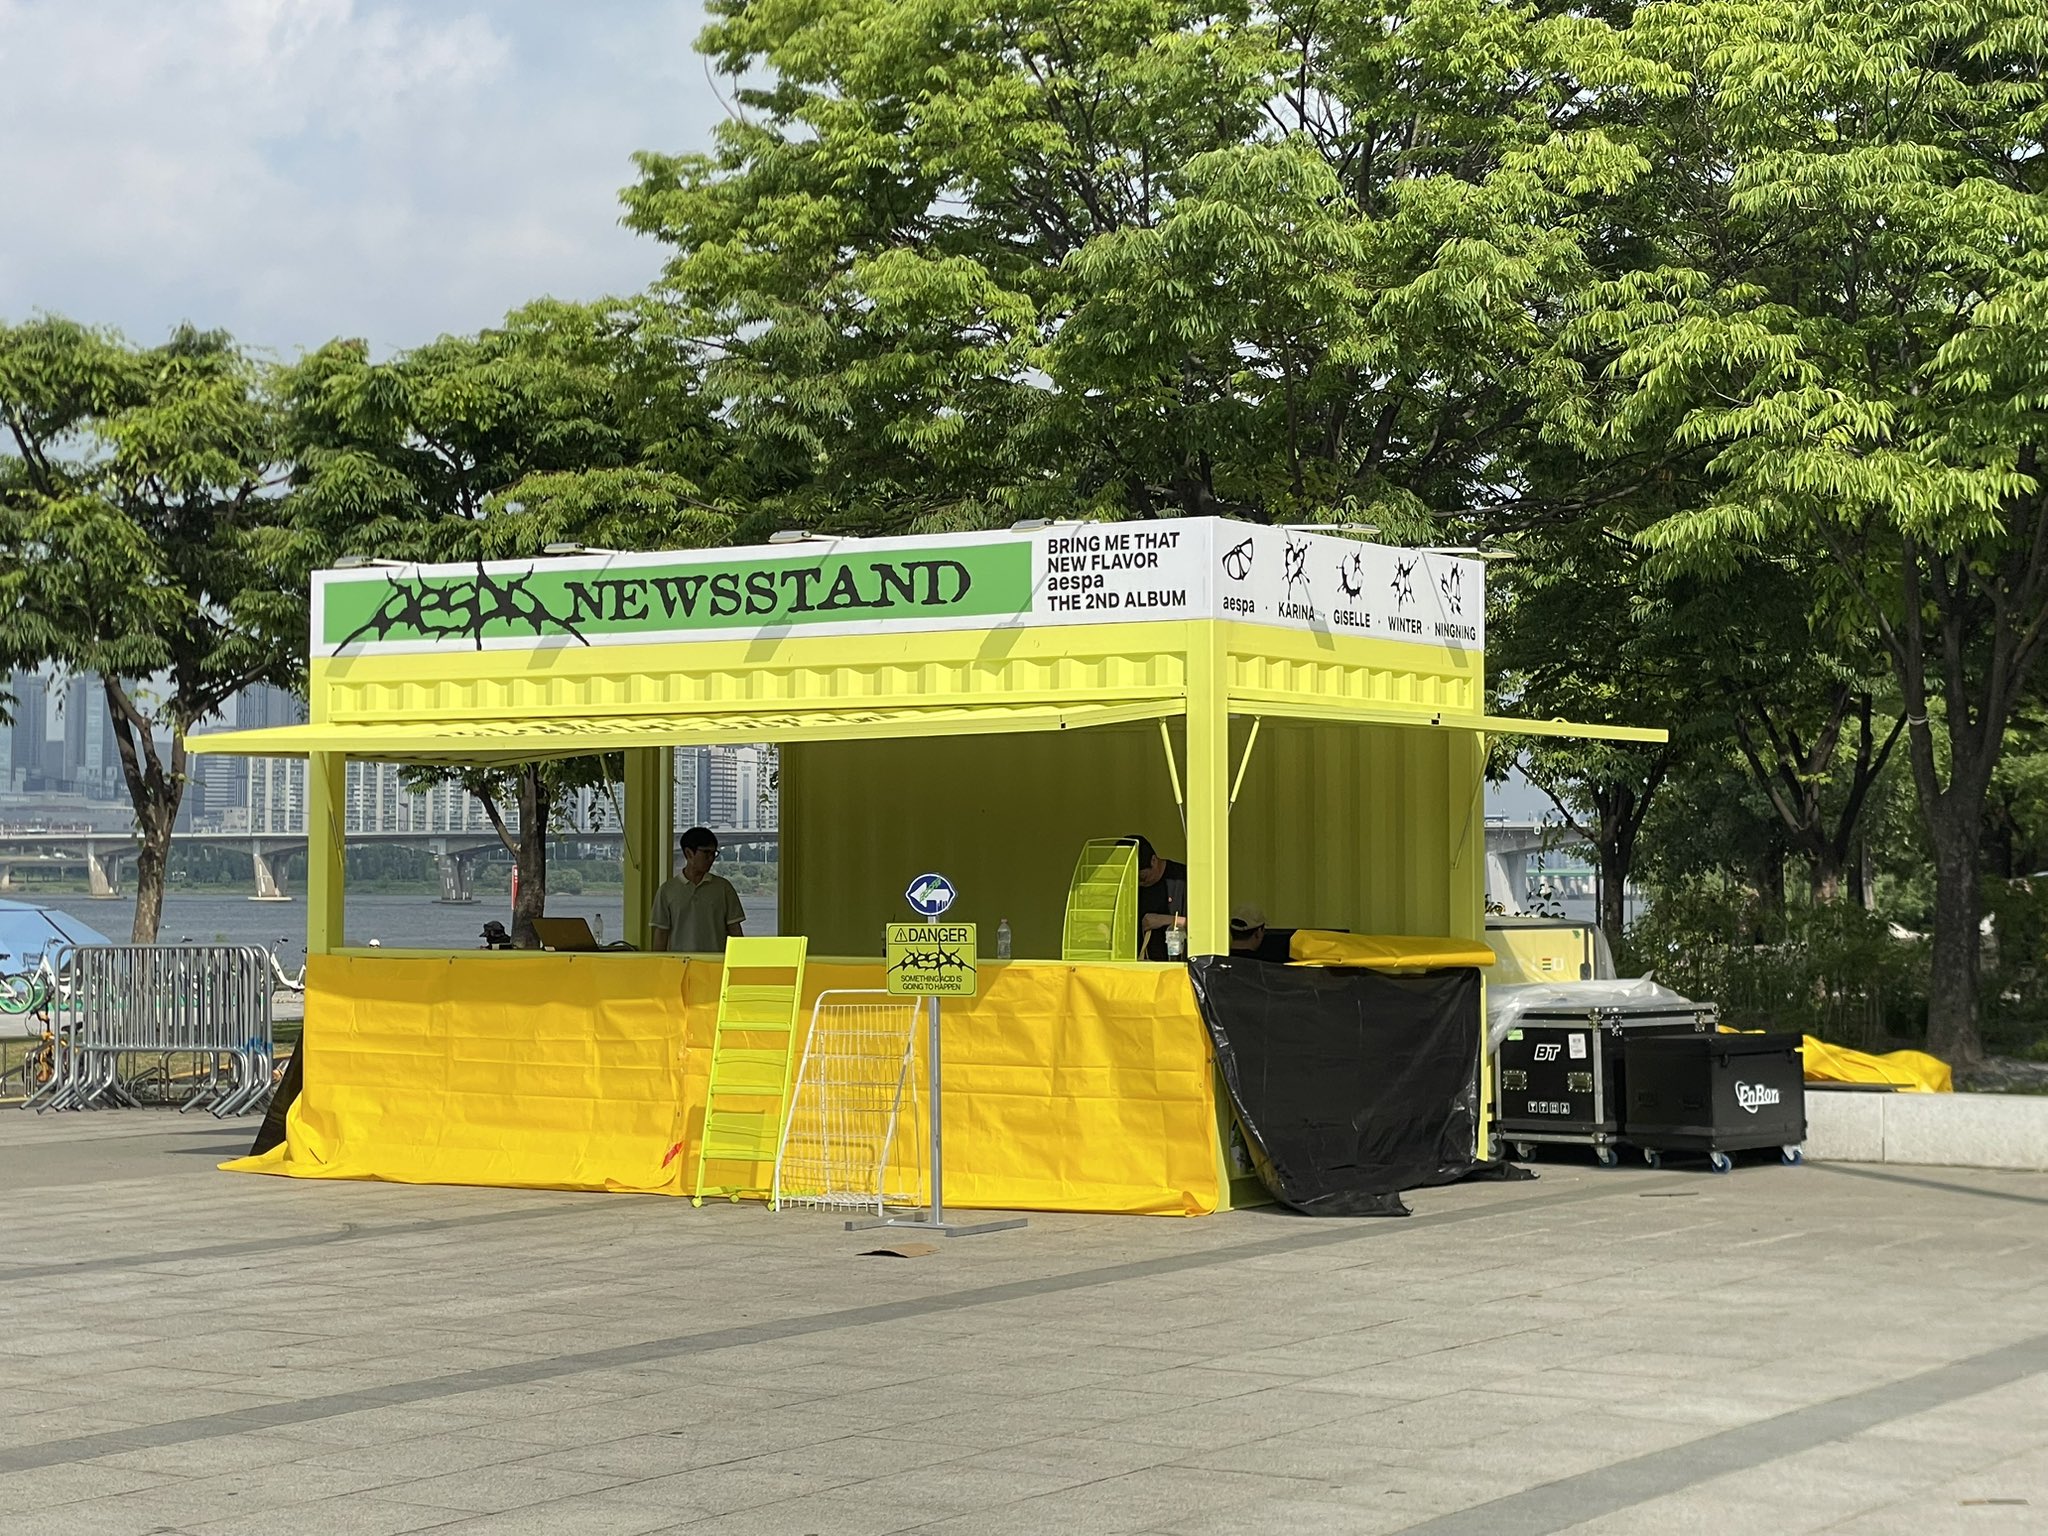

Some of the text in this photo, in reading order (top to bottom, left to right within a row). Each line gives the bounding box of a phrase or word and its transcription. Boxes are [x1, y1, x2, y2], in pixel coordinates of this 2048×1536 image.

[1048, 532, 1180, 554] BRING ME THAT
[1047, 552, 1159, 573] NEW FLAVOR
[564, 560, 971, 623] NEWSSTAND
[1047, 573, 1104, 593] aespa
[1047, 590, 1187, 612] THE 2ND ALBUM
[1222, 595, 1476, 641] aespa KARINA GISELLE WINTER NINGNING
[908, 927, 968, 943] DANGER
[901, 974, 963, 983] SOMETHING ACID IS
[902, 982, 961, 991] GOING TO HAPPEN
[1534, 1043, 1561, 1061] BT
